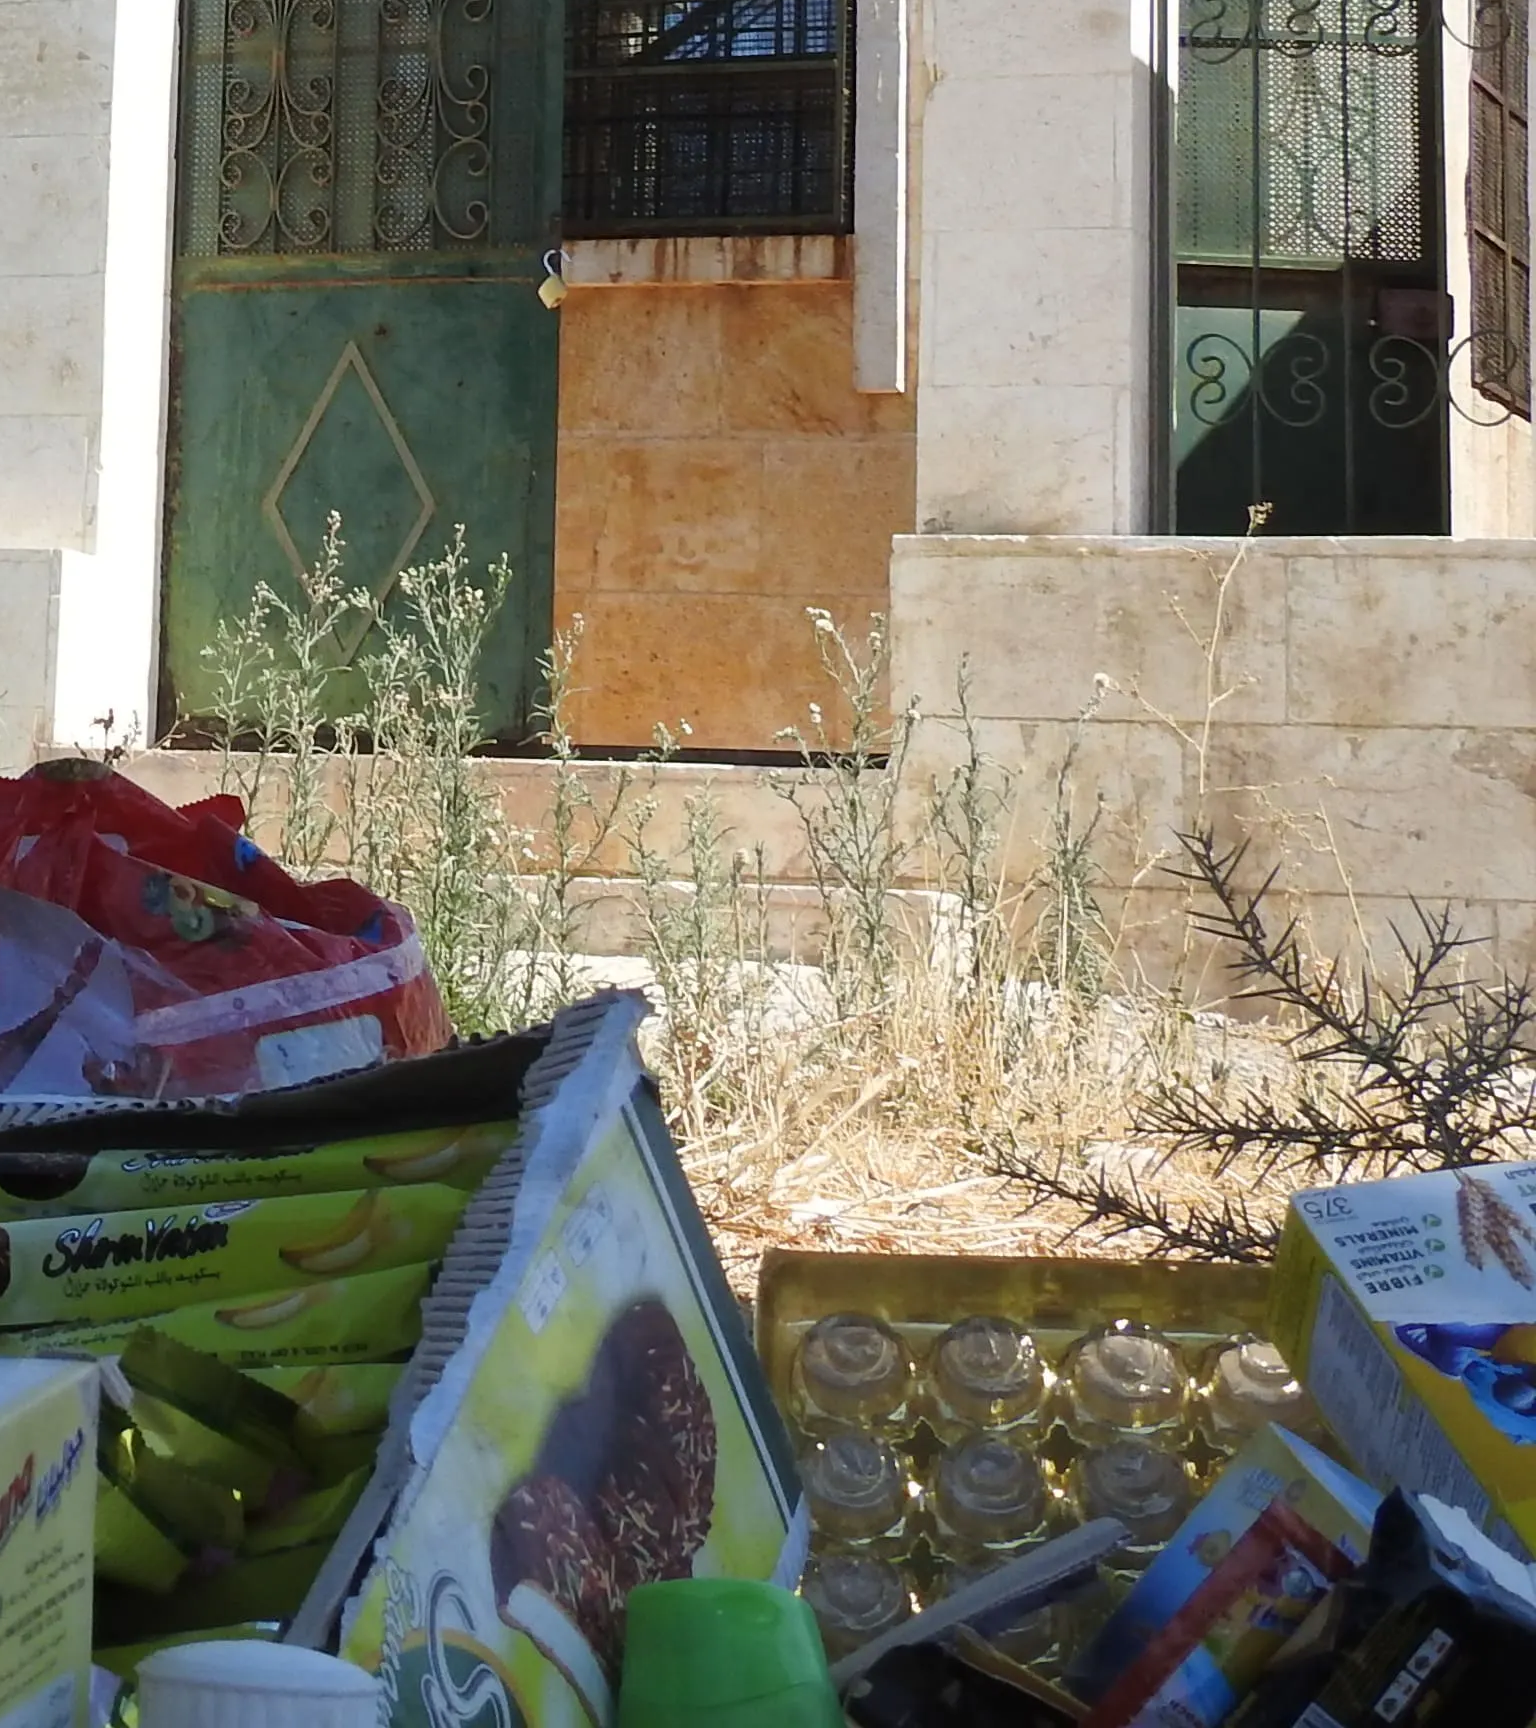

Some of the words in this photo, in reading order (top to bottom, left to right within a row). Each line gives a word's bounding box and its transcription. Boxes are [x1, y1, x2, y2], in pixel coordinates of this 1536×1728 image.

[1303, 1196, 1354, 1221] 375
[1333, 1224, 1420, 1248] MINERALS
[1349, 1248, 1426, 1270] VITAMINS
[1363, 1273, 1425, 1296] FIBRE
